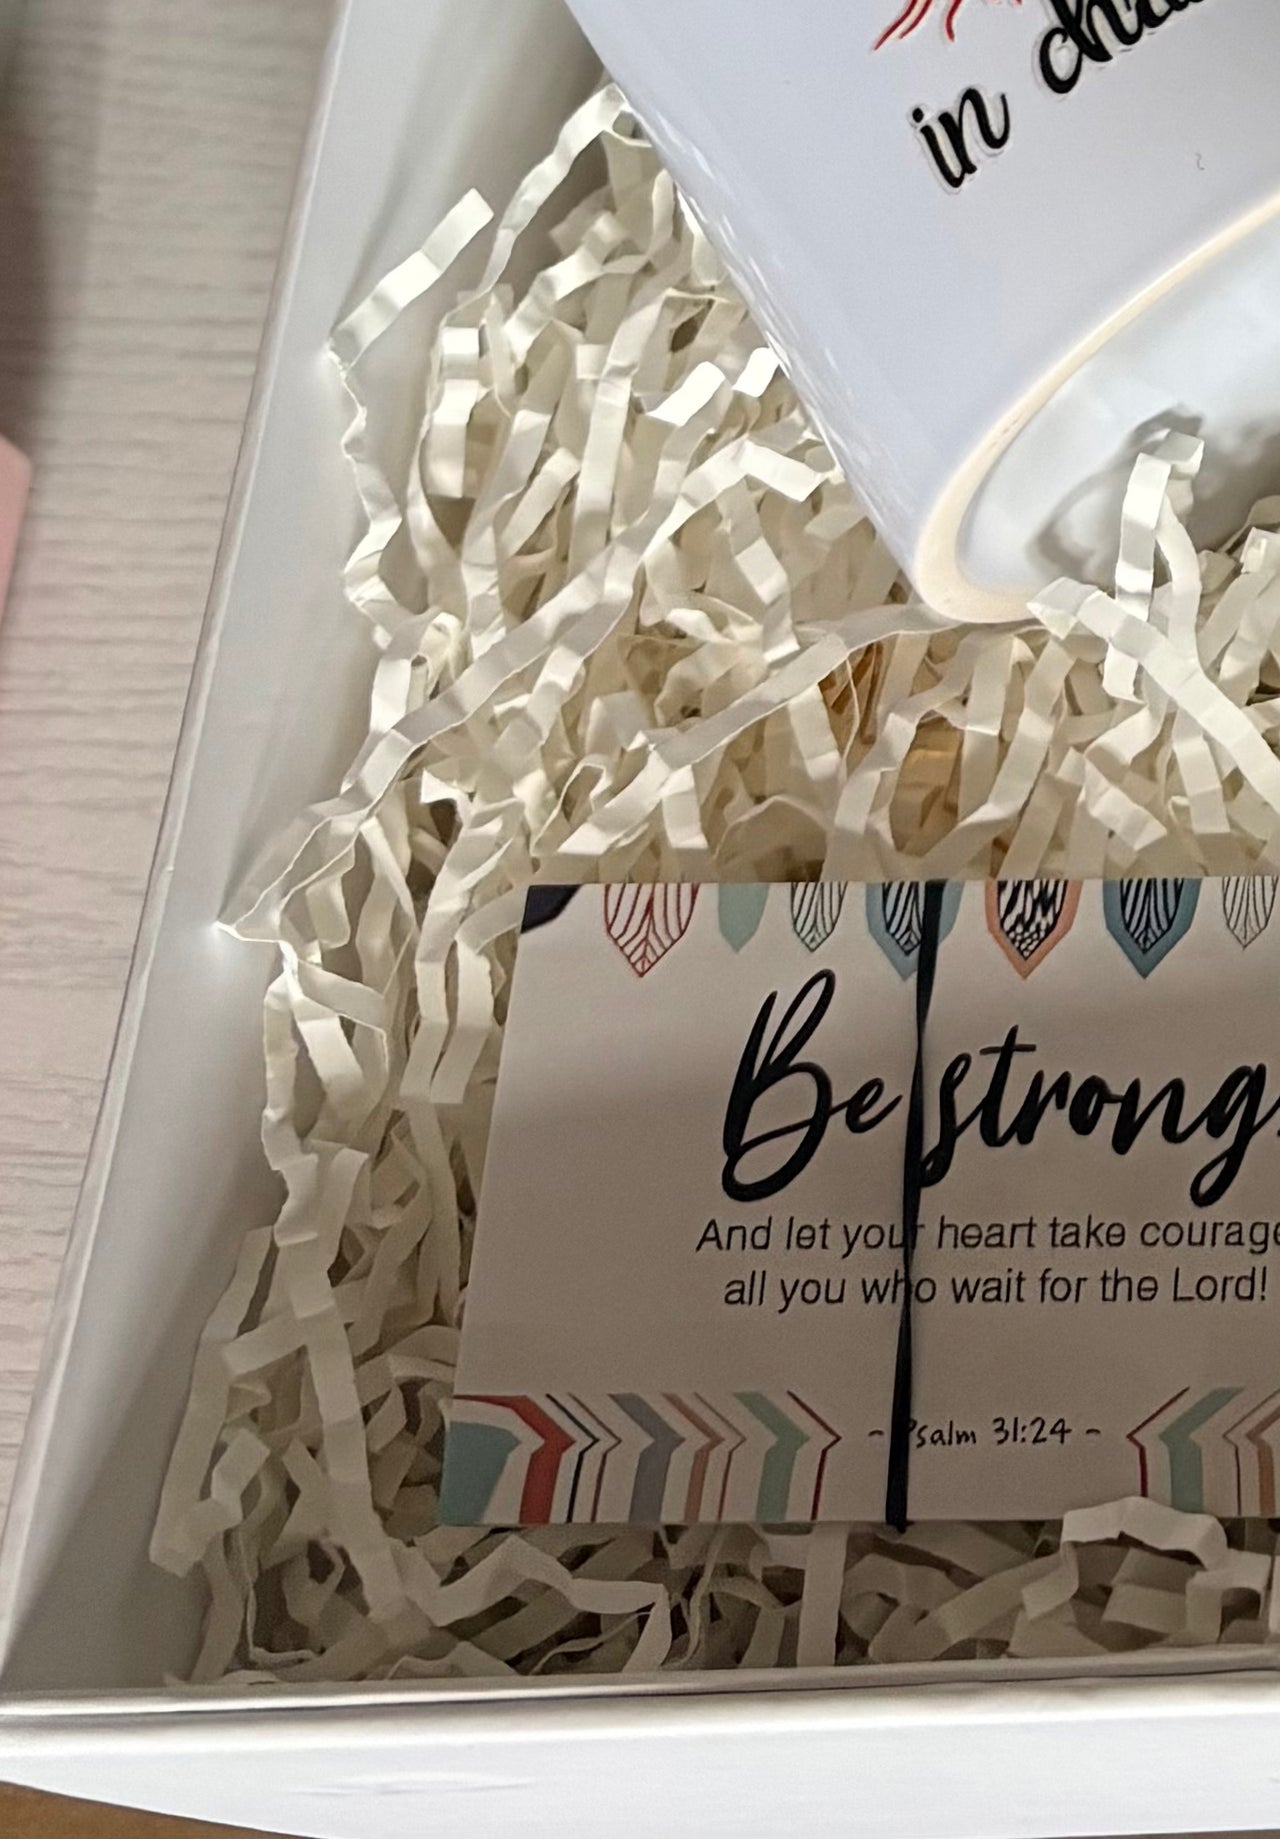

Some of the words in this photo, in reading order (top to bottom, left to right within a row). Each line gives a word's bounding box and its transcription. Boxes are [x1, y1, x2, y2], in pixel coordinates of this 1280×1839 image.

[912, 87, 1010, 189] in
[721, 969, 903, 1203] Be
[695, 1215, 774, 1253] And
[785, 1215, 833, 1252] let
[841, 1223, 926, 1260] your
[937, 1214, 1038, 1250] heart
[1048, 1213, 1127, 1249] take
[724, 1269, 767, 1306] all
[777, 1278, 847, 1315] you
[861, 1268, 938, 1305] who
[951, 1267, 1027, 1305] wait
[1039, 1267, 1090, 1304] for
[1100, 1266, 1160, 1303] the
[1172, 1265, 1269, 1303] Lord!
[992, 1416, 1073, 1446] 31:24
